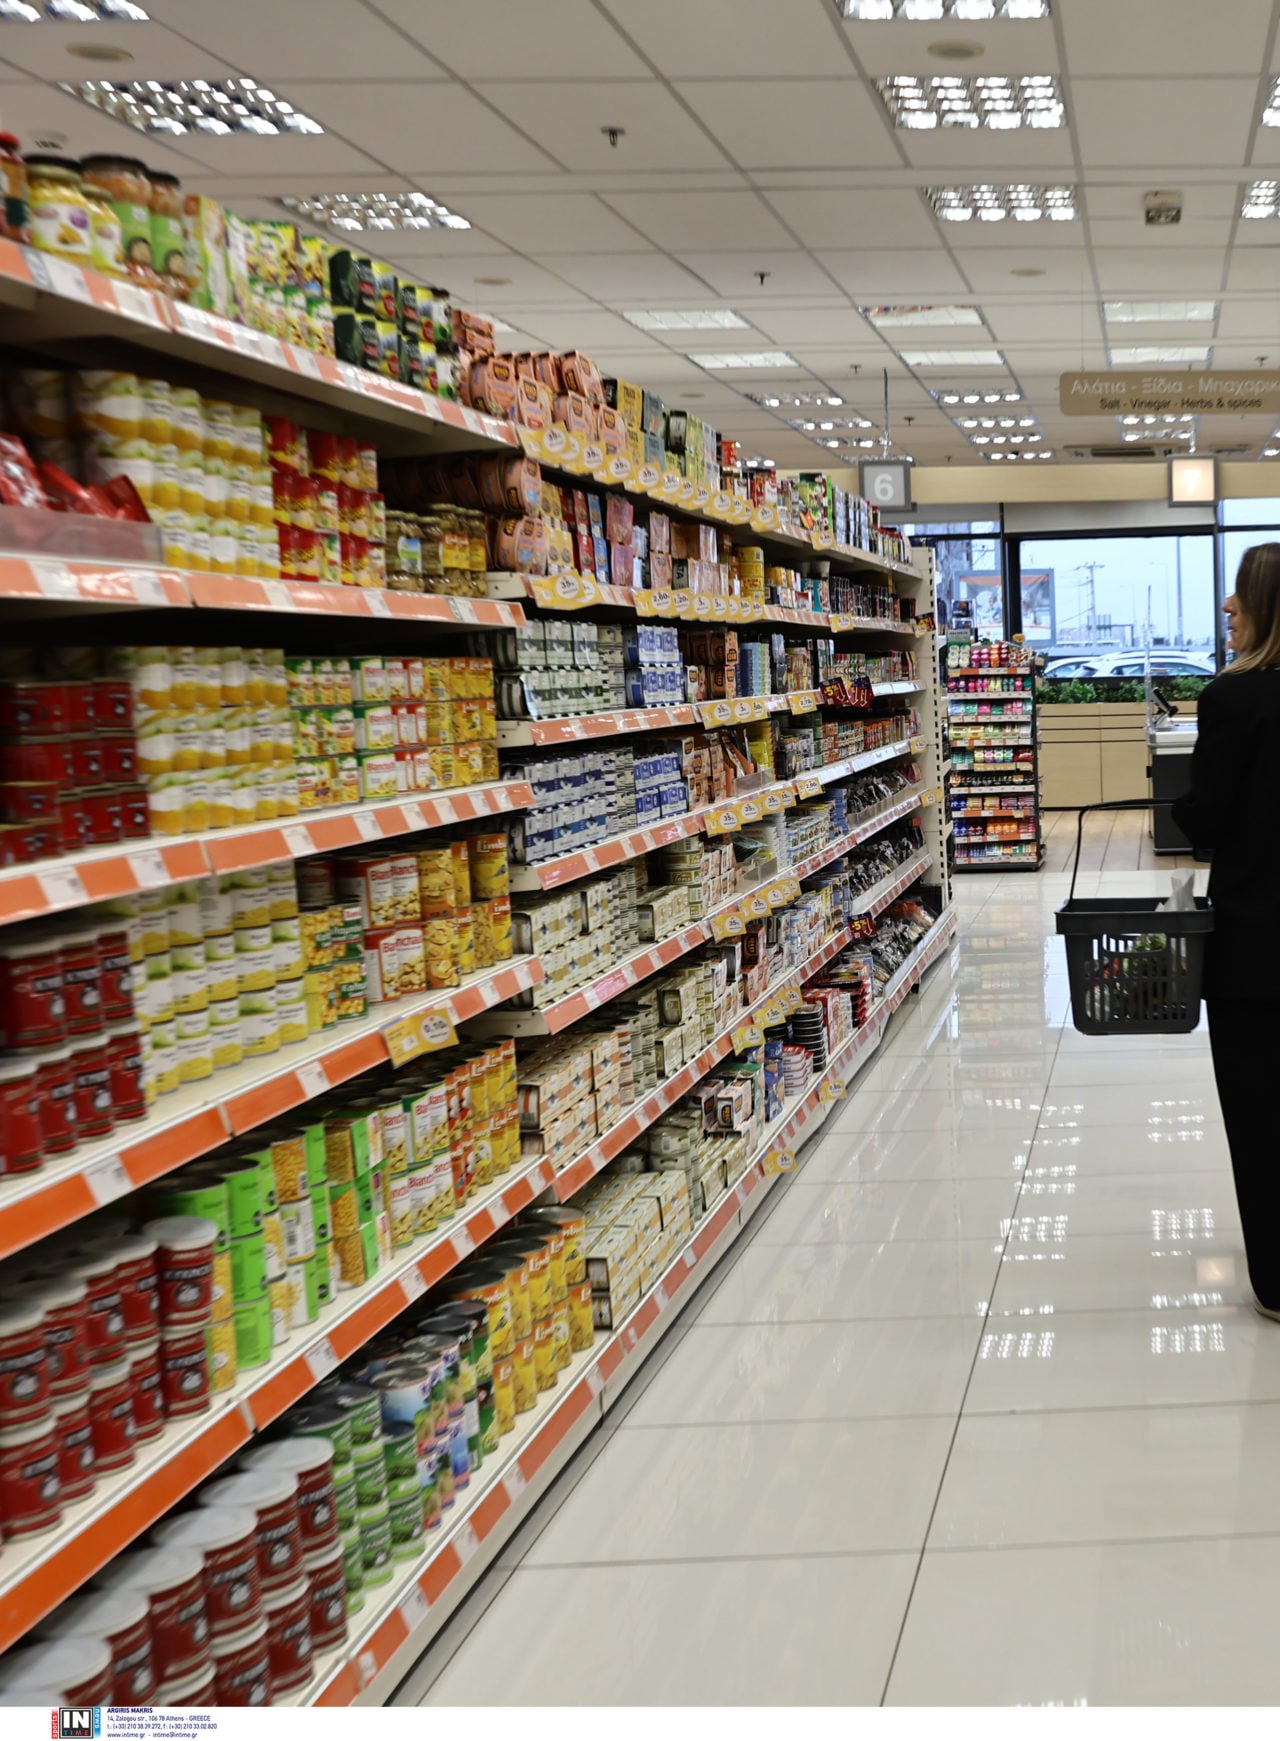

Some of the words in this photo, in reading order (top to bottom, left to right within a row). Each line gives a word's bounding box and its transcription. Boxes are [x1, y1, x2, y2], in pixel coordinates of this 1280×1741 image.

[1071, 378, 1127, 394] Αλάτια
[1141, 377, 1184, 394] Ξίδια
[1099, 398, 1120, 409] Salt
[1129, 398, 1171, 411] Vinegar
[1180, 397, 1213, 409] Herbs
[1227, 397, 1263, 410] spices
[873, 473, 895, 501] 6
